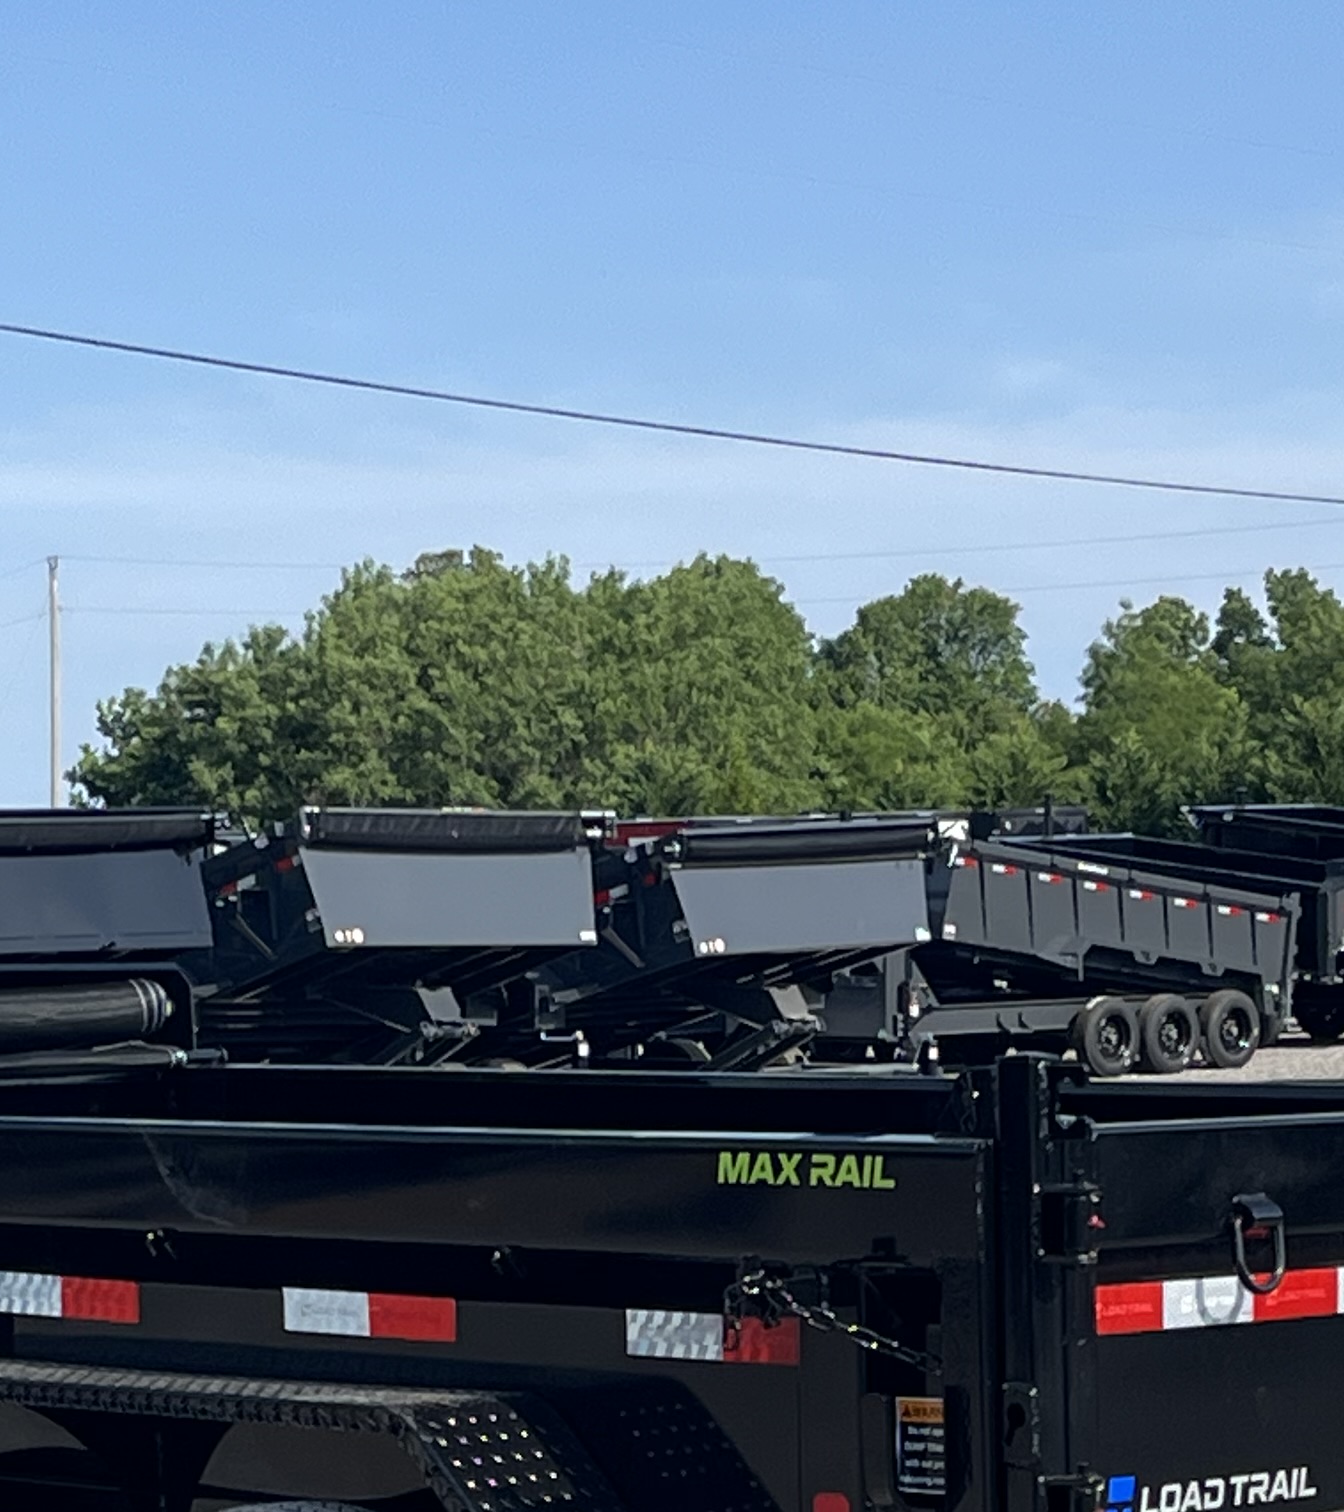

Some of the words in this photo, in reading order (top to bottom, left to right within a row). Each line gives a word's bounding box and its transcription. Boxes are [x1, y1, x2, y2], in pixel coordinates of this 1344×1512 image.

[717, 1151, 803, 1186] MAX
[809, 1154, 897, 1190] RAIL
[1228, 1466, 1318, 1507] TRAIL
